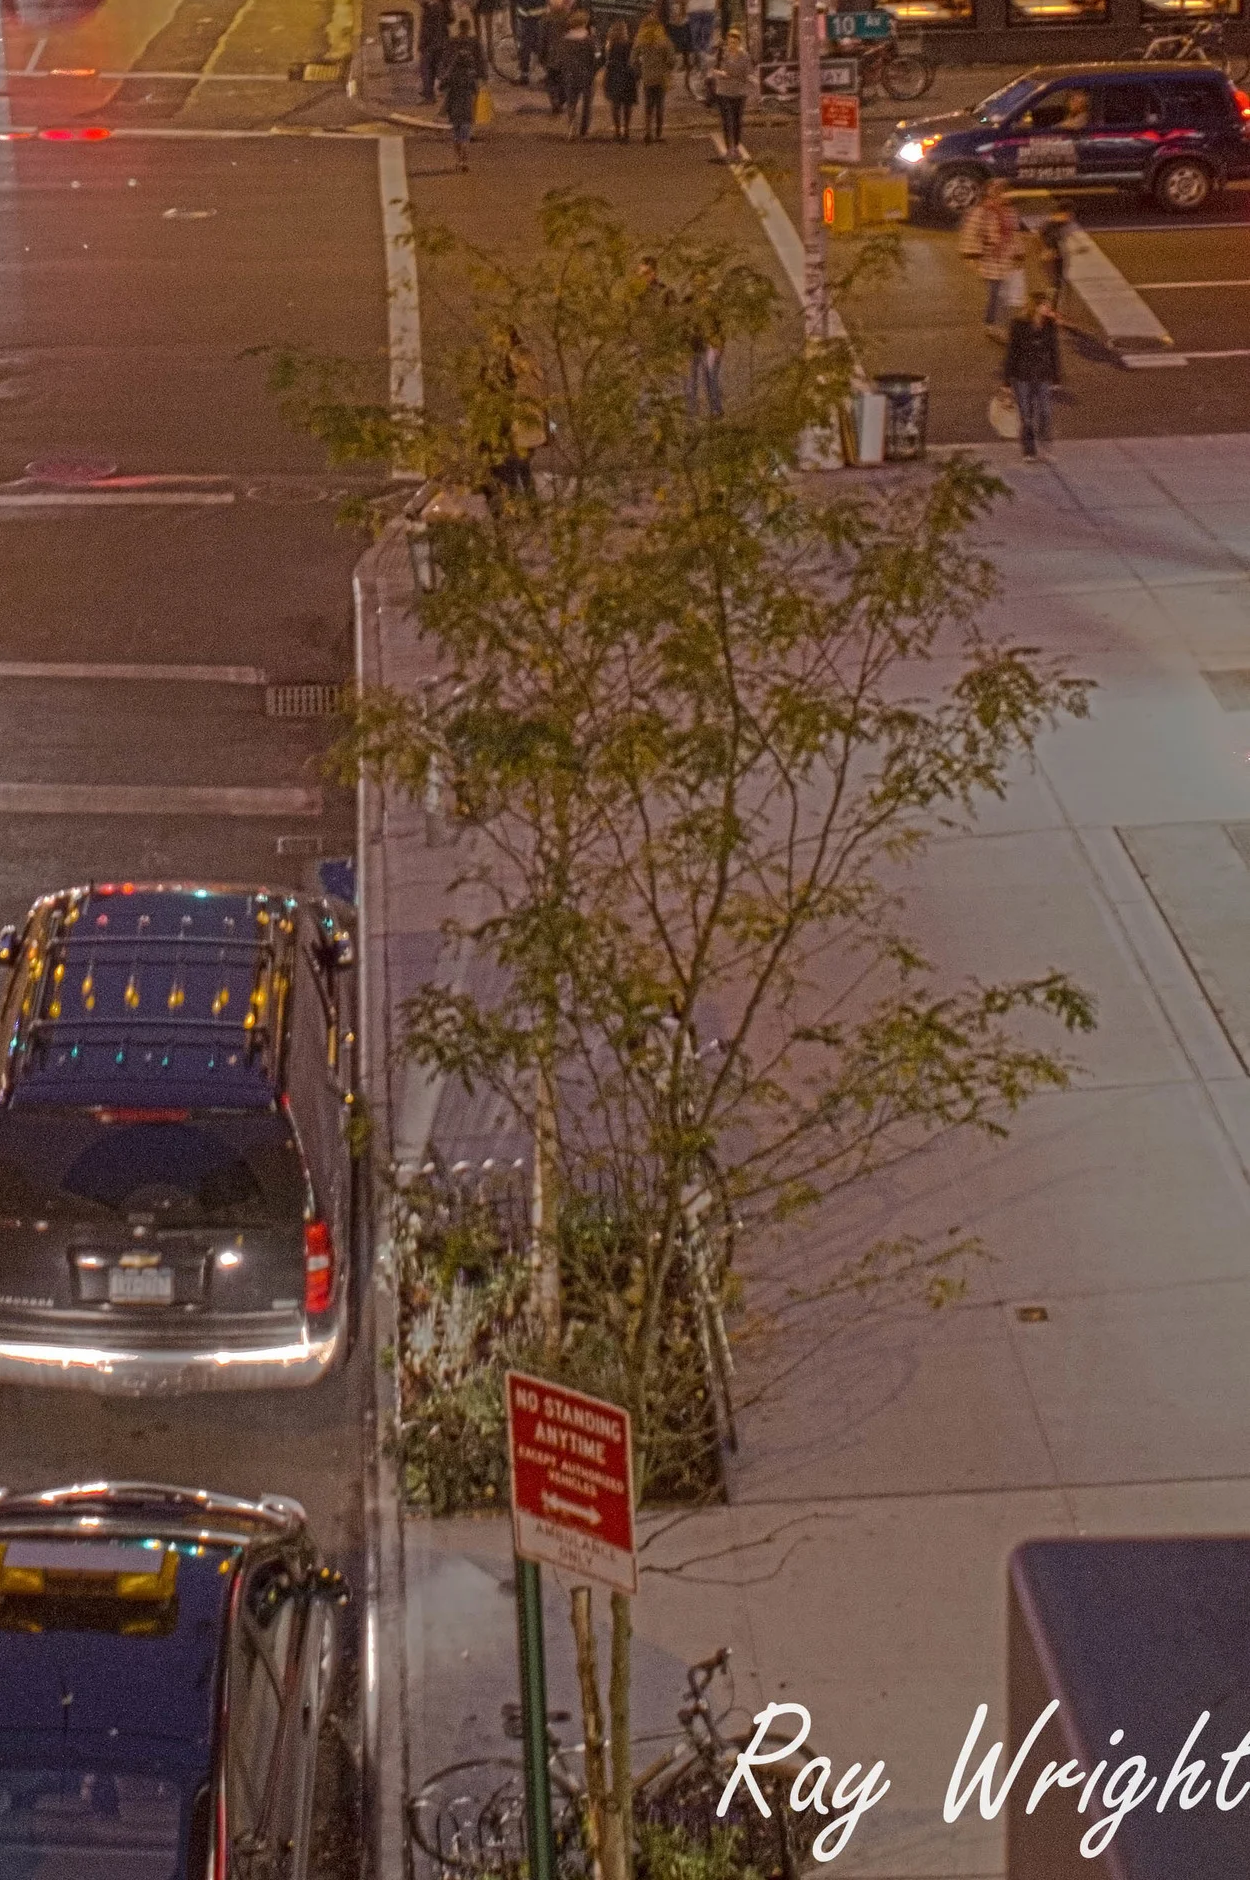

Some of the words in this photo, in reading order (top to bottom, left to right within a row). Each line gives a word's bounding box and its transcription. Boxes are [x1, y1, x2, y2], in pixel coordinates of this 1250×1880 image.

[833, 16, 856, 37] 10
[515, 1385, 539, 1413] NO
[543, 1395, 622, 1443] STANDING
[534, 1419, 607, 1465] ANYTIME
[558, 1547, 592, 1566] ONLY
